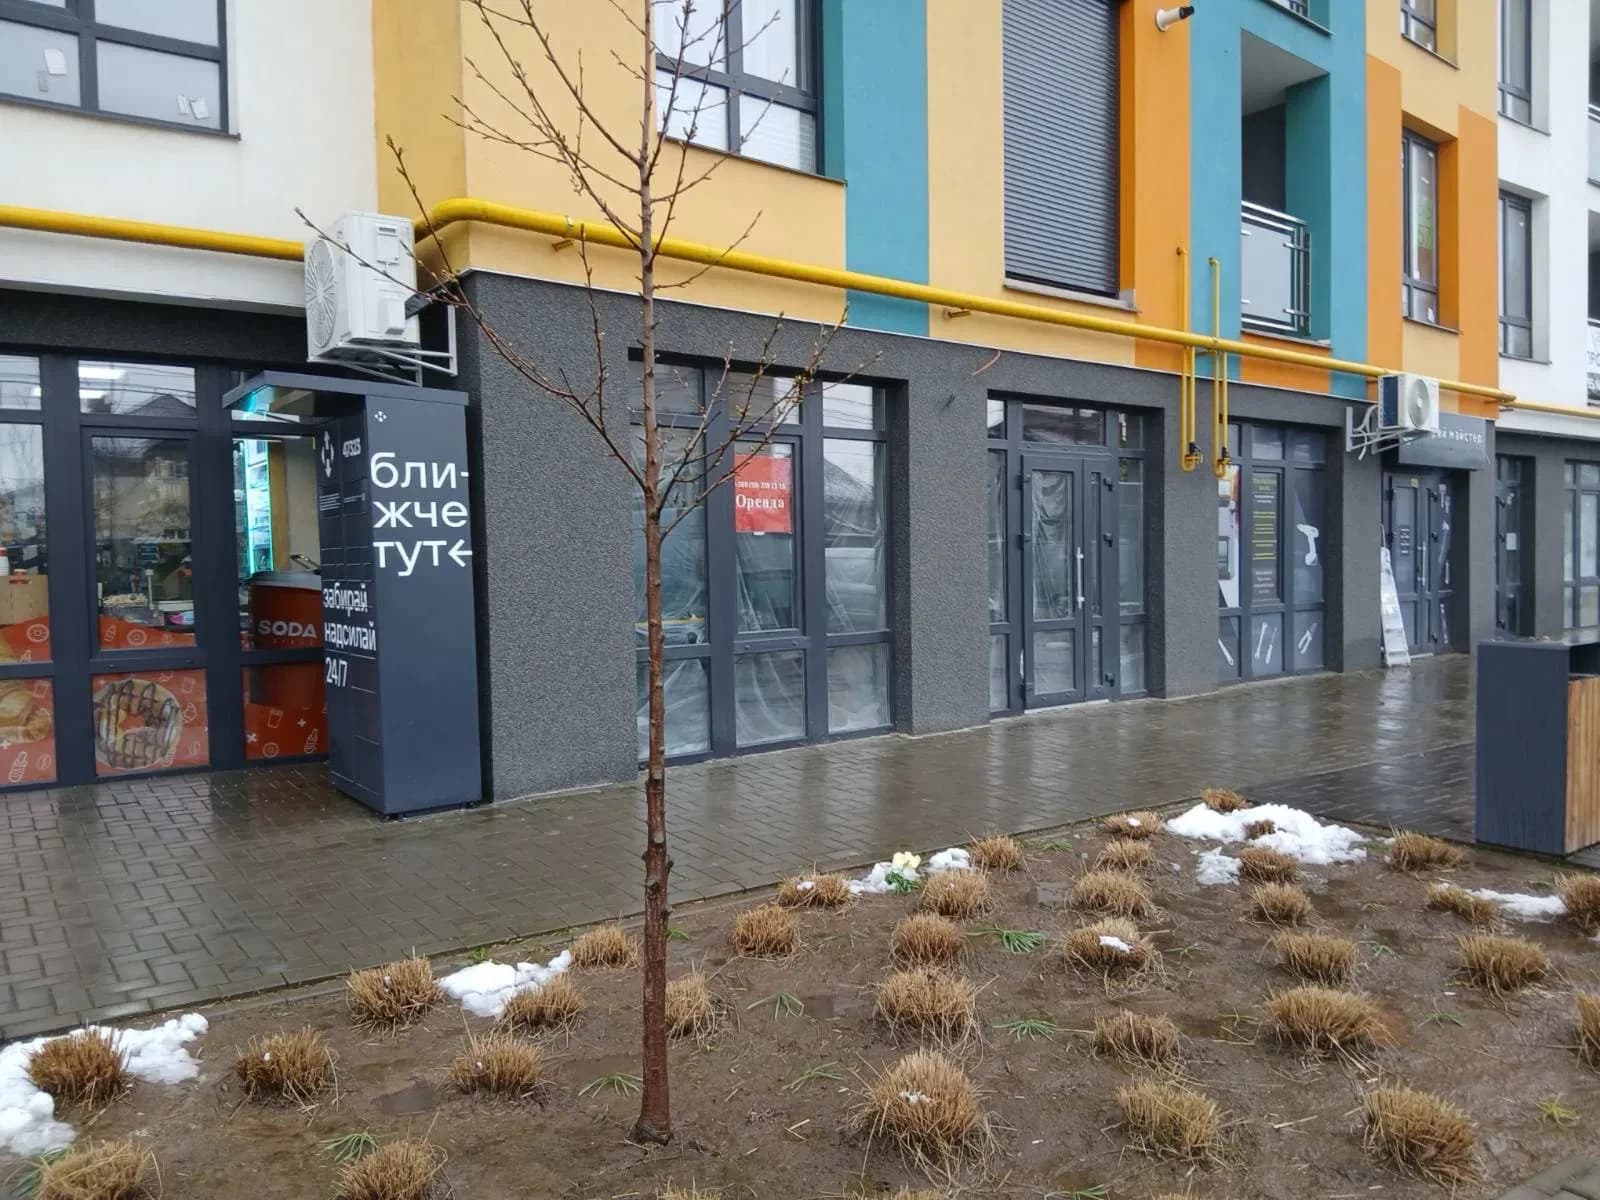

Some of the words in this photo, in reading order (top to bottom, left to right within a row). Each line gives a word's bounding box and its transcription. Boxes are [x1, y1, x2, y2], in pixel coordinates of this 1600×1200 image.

[370, 452, 470, 489] бли-
[373, 500, 468, 528] жче
[736, 494, 784, 511] Оренда
[373, 539, 446, 577] тут
[323, 582, 368, 617] забирай
[257, 619, 317, 639] SODA
[324, 621, 377, 651] надсилай
[325, 656, 348, 688] 24/7
